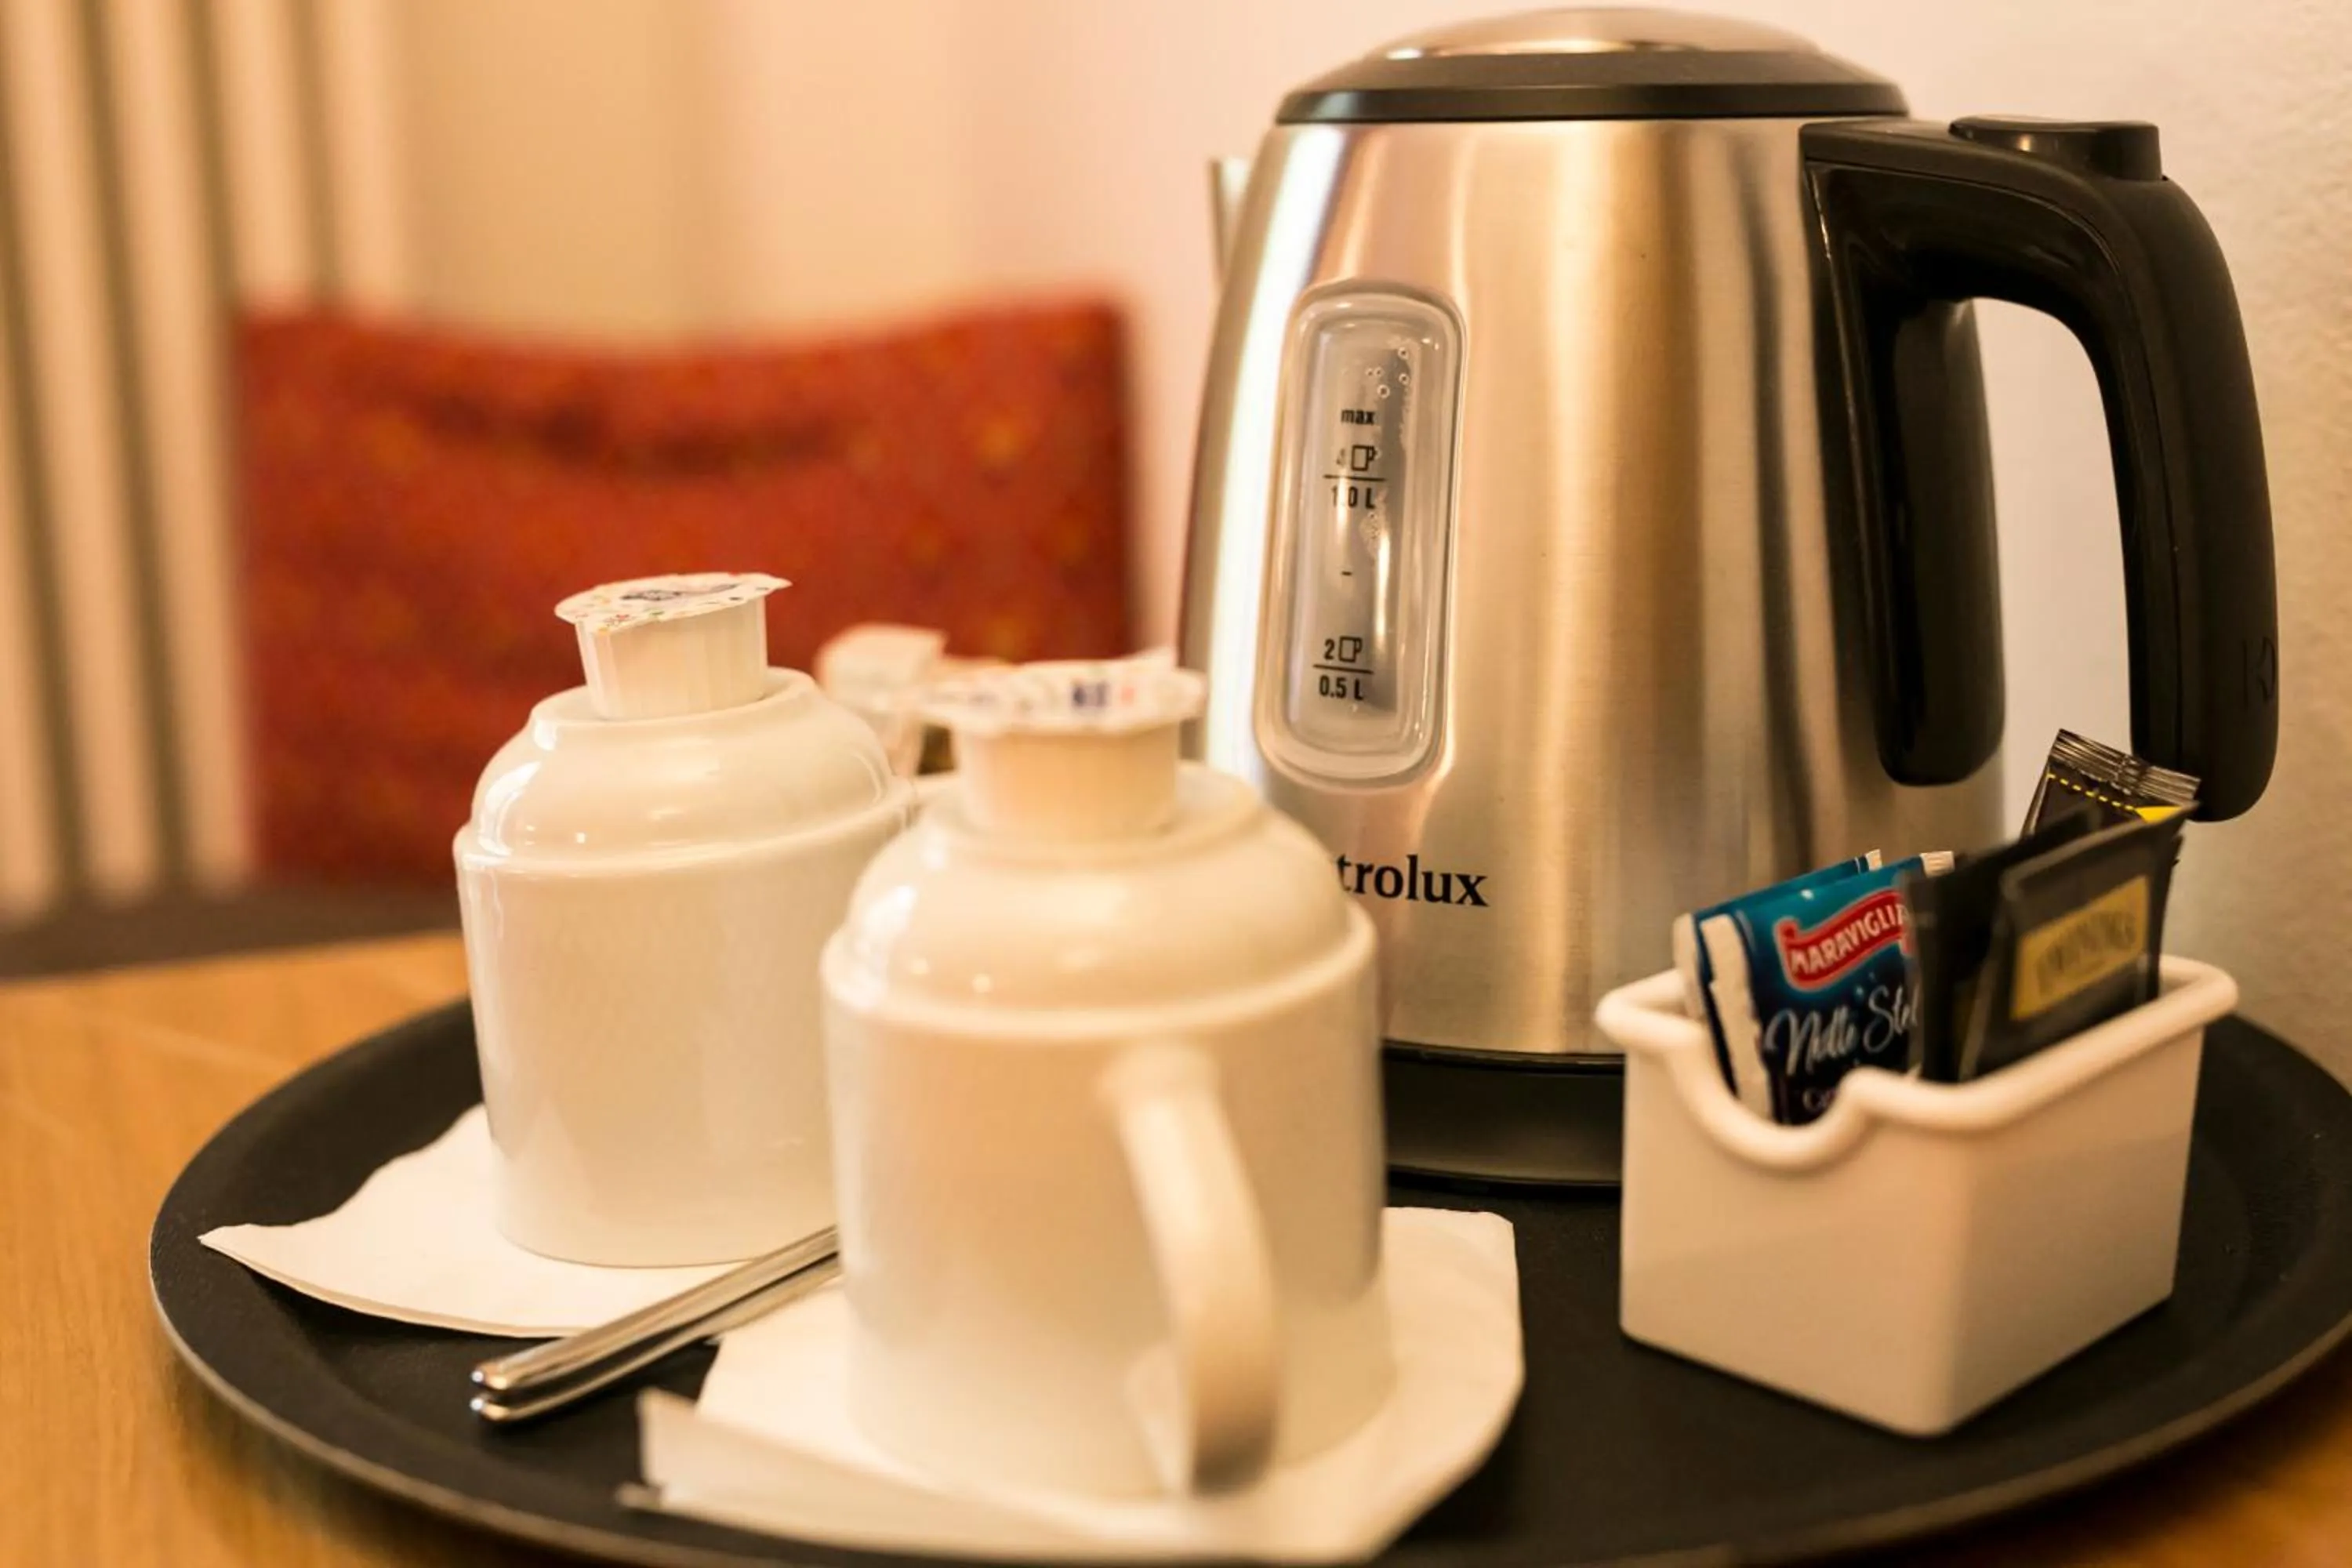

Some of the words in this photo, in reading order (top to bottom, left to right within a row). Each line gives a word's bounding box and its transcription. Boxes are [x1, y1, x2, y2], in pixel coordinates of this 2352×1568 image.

[1341, 409, 1376, 425] max
[1332, 485, 1358, 508] 10
[1365, 487, 1376, 510] L
[1324, 638, 1334, 659] 2
[1319, 674, 1347, 699] 0.5
[1354, 678, 1363, 700] L
